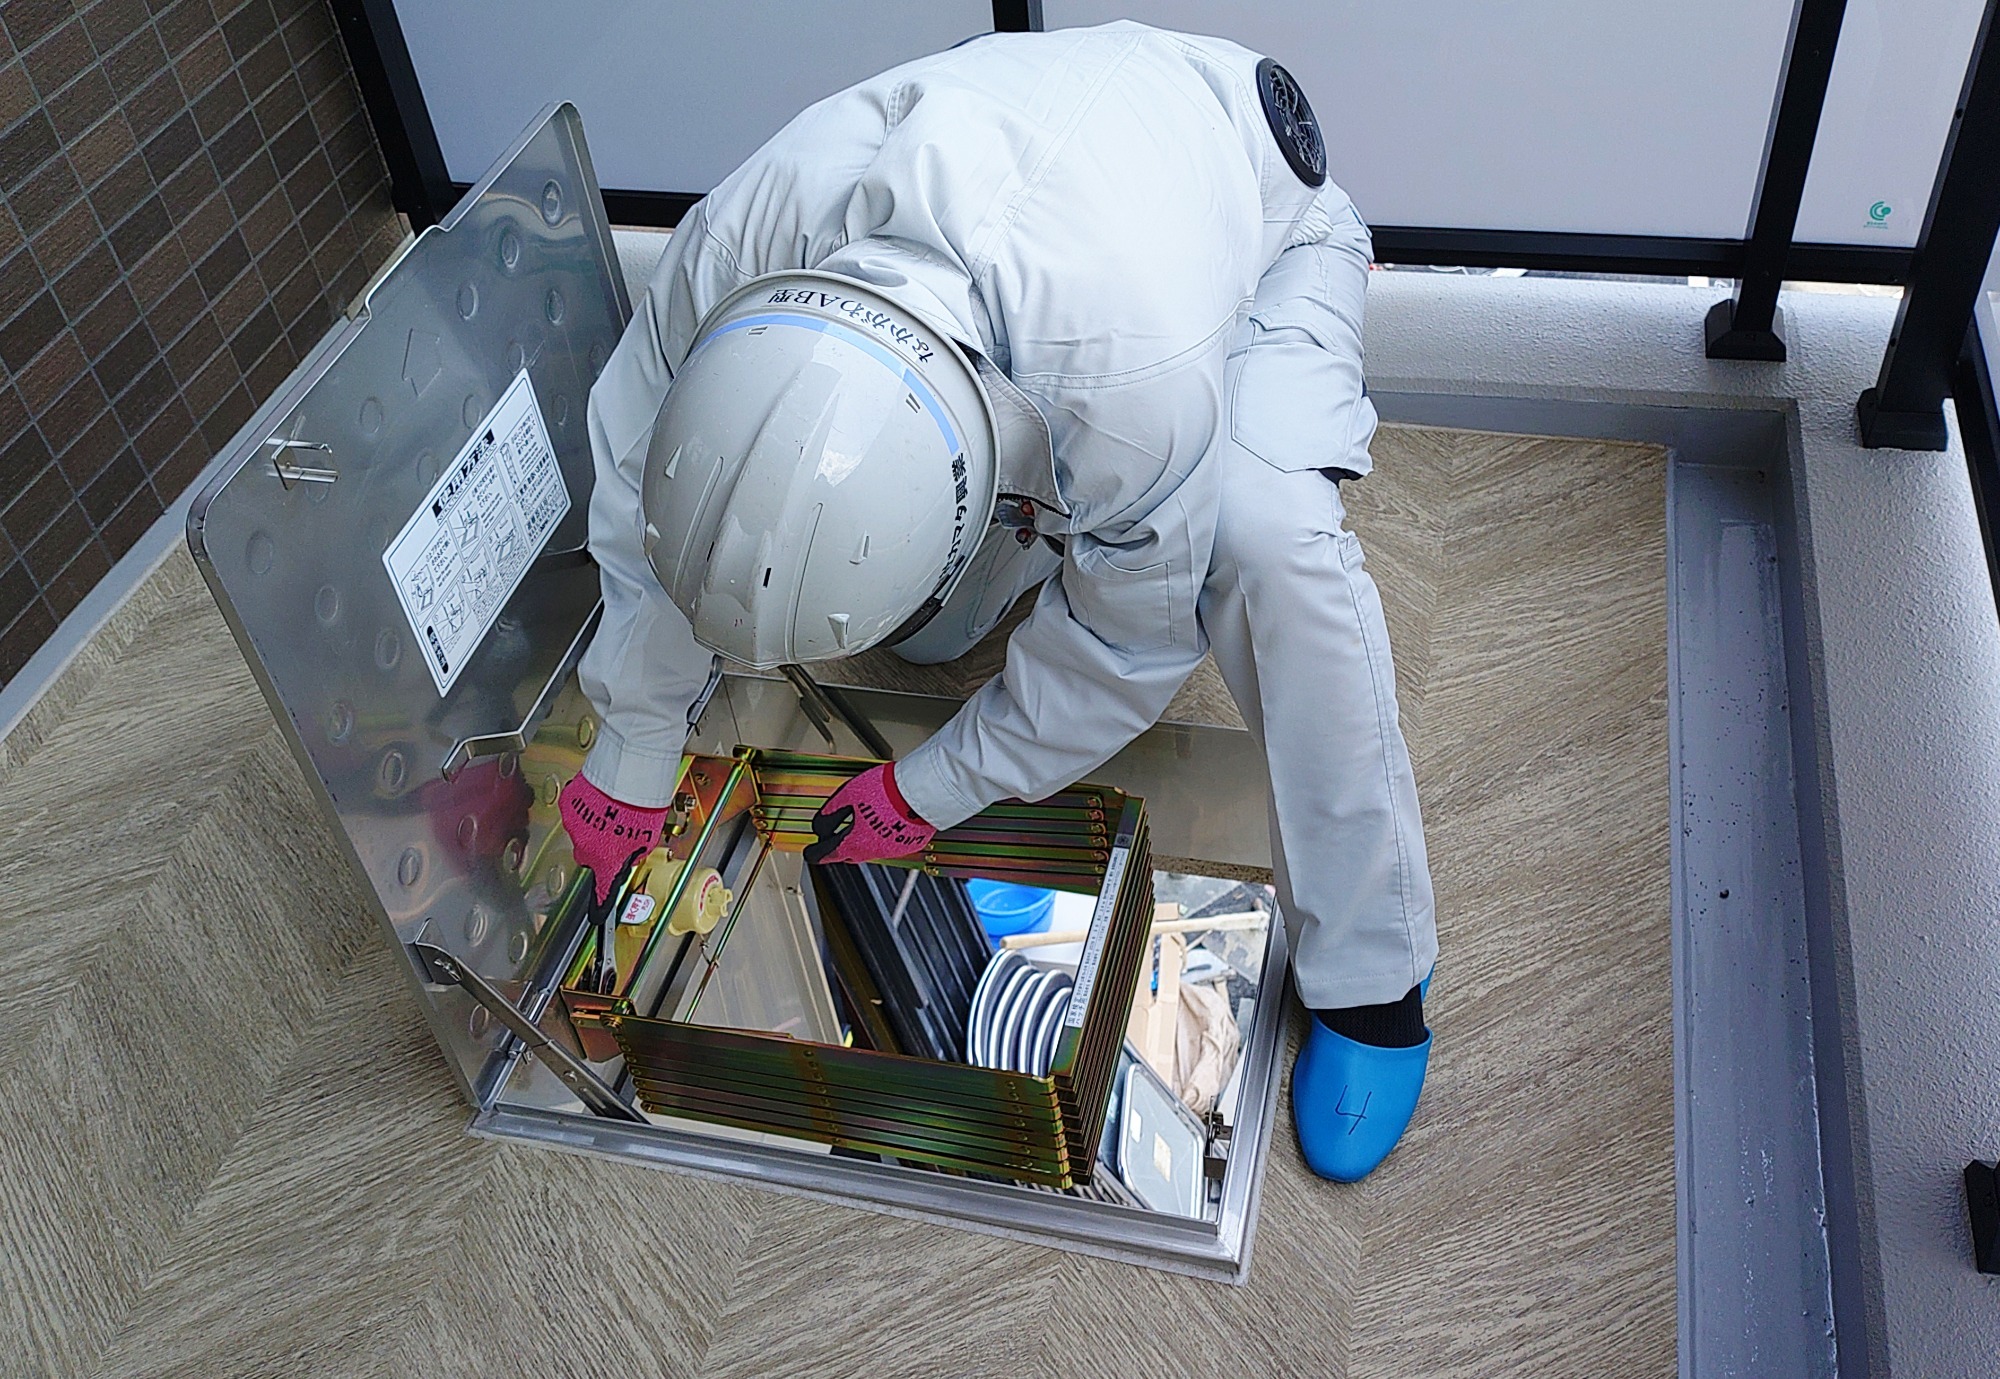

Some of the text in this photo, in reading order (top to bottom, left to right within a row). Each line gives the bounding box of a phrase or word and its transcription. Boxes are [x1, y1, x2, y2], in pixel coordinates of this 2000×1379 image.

[767, 289, 933, 363] なかがわAB型
[435, 433, 490, 512] 使用方法
[604, 805, 619, 821] M
[891, 820, 907, 833] M
[1335, 1085, 1372, 1135] 4
